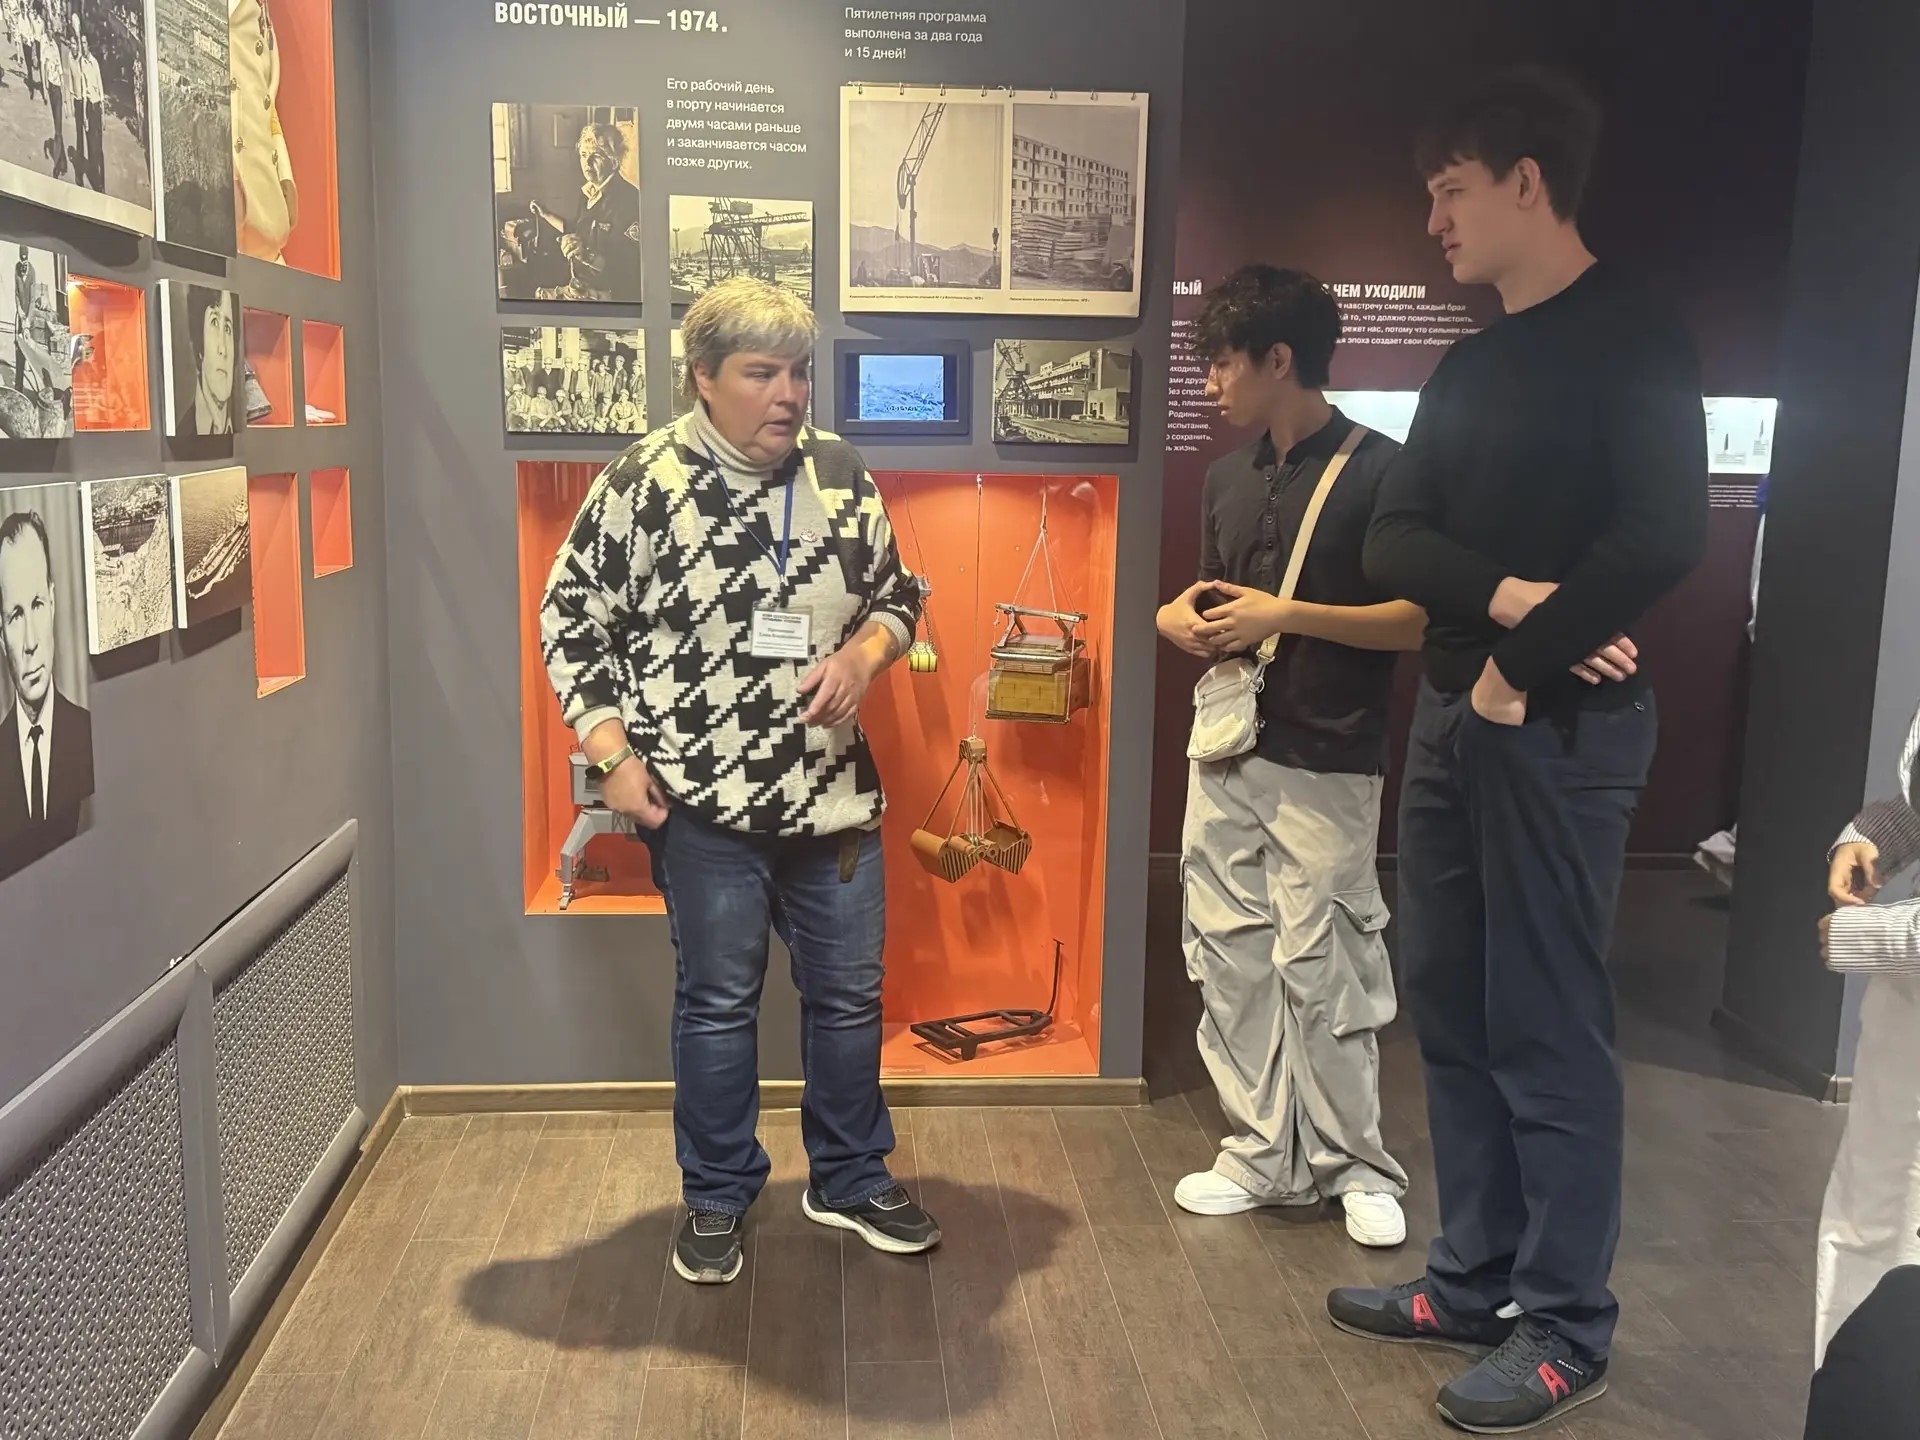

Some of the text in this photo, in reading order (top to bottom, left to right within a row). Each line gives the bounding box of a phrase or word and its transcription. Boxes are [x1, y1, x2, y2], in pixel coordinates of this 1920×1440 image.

[495, 2, 628, 28] ВОСТОЧНЫЙ
[667, 10, 728, 33] 1974.
[845, 7, 986, 24] Пятилетняя программа
[845, 28, 983, 43] выполнена за два года
[845, 46, 906, 60] и 15 дней!
[667, 78, 774, 94] Его рабочий день
[667, 100, 784, 113] в порту начинается
[666, 119, 801, 134] двумя часами раньше
[667, 138, 807, 152] и заканчивается часом
[667, 157, 752, 170] позже других.
[1173, 280, 1202, 295] НЫЙ
[1333, 284, 1360, 298] ЧЕМ
[1365, 285, 1426, 300] УХОДИЛИ
[1386, 327, 1412, 335] потому
